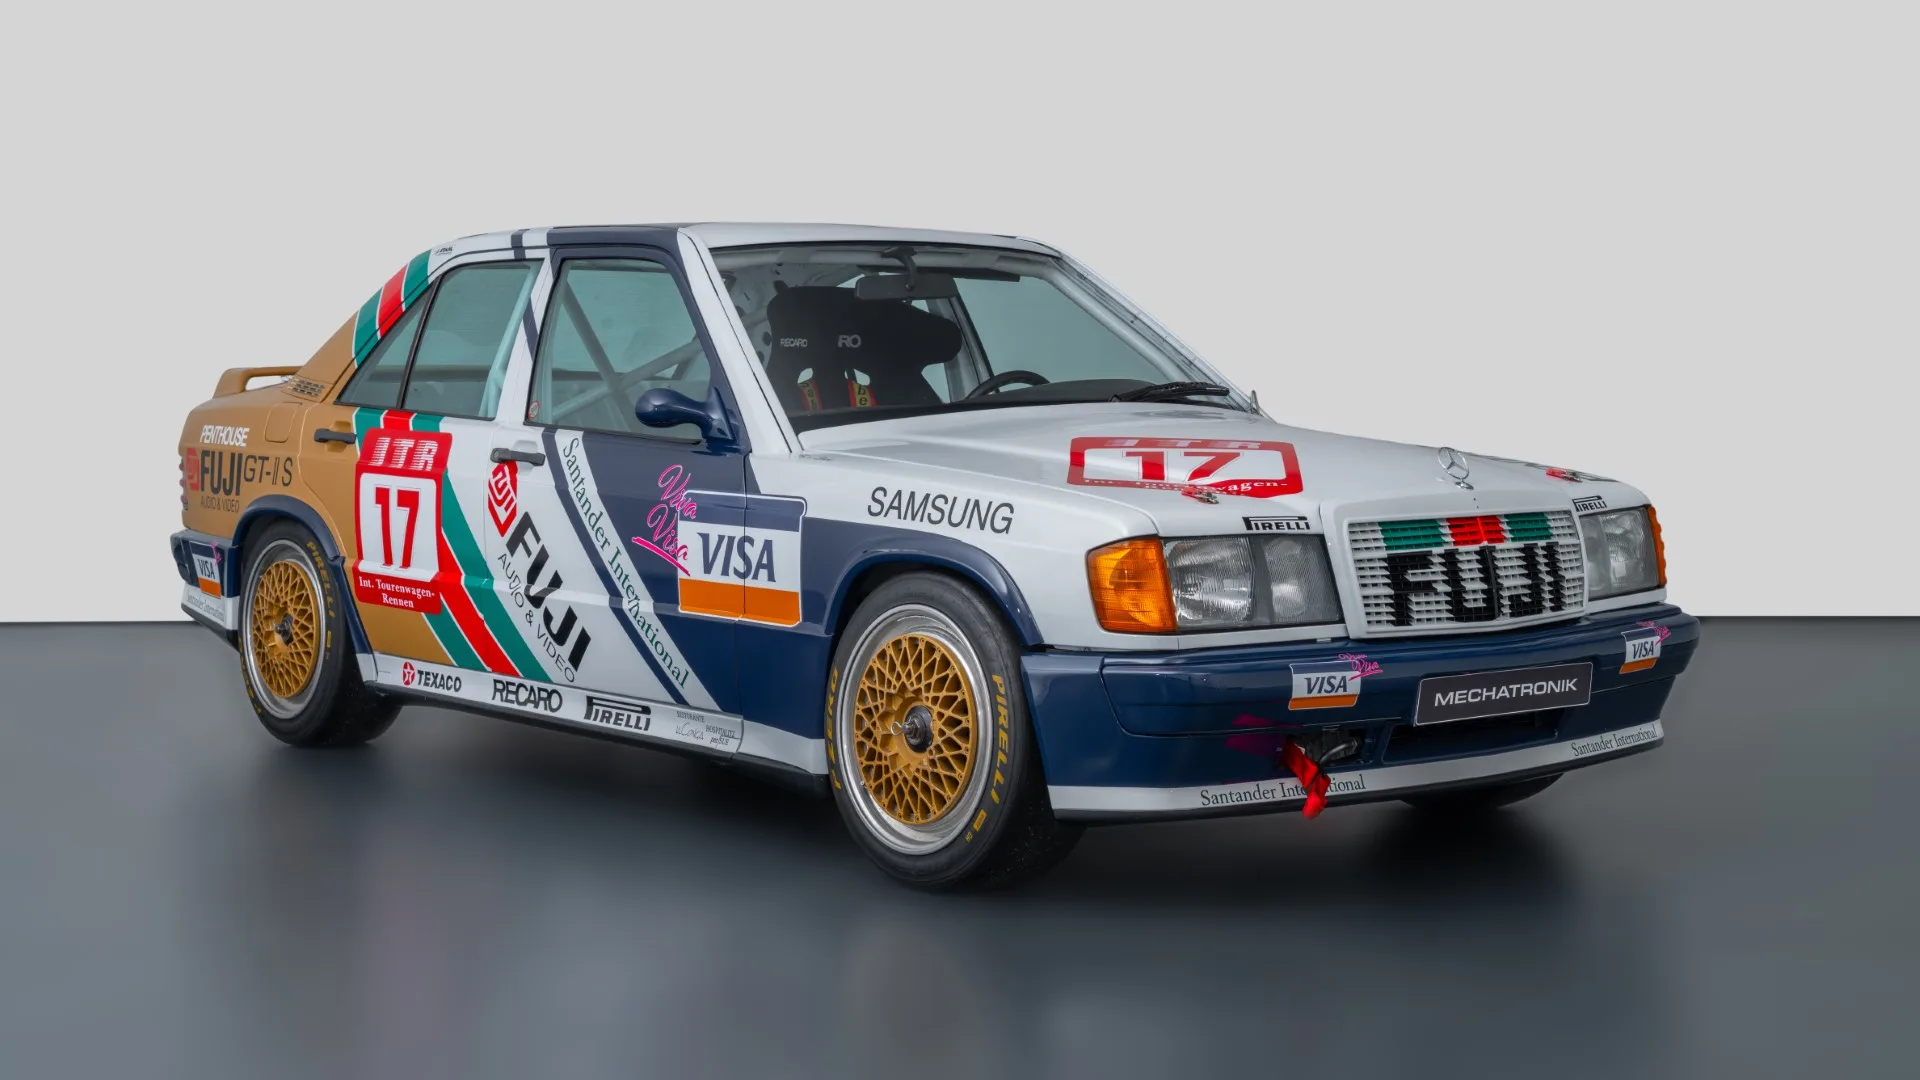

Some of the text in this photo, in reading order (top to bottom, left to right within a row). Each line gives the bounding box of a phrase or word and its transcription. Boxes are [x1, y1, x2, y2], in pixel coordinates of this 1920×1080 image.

[780, 338, 808, 348] RECARO
[200, 425, 250, 447] PENTHOUSE
[368, 437, 439, 472] ITR
[1124, 450, 1242, 482] 17
[201, 450, 243, 496] FUJI
[658, 464, 697, 519] Viva
[1572, 495, 1607, 512] PIRELLI
[374, 484, 421, 570] 17
[867, 486, 1015, 534] SAMSUNG
[1242, 516, 1311, 531] PIRELLI
[646, 504, 689, 561] Visa
[197, 558, 216, 580] VISA
[563, 438, 689, 689] Santander International
[697, 532, 777, 583] VISA
[359, 575, 436, 599] Int. Tourenwagen-
[382, 592, 414, 608] Rennen
[505, 511, 592, 672] FUJI
[1387, 541, 1567, 627] FUJI
[498, 553, 575, 683] AUDIO & VIDEO
[1631, 640, 1654, 660] VISA
[417, 670, 462, 693] TEXACO
[491, 678, 563, 713] RECARO
[1304, 676, 1348, 695] VISA
[1434, 678, 1578, 707] MECHATRONIK
[583, 695, 651, 732] PIRELLI
[990, 674, 1009, 804] PIRELLI
[1571, 724, 1658, 757] Santander International
[1200, 773, 1367, 806] Santander Intetional
